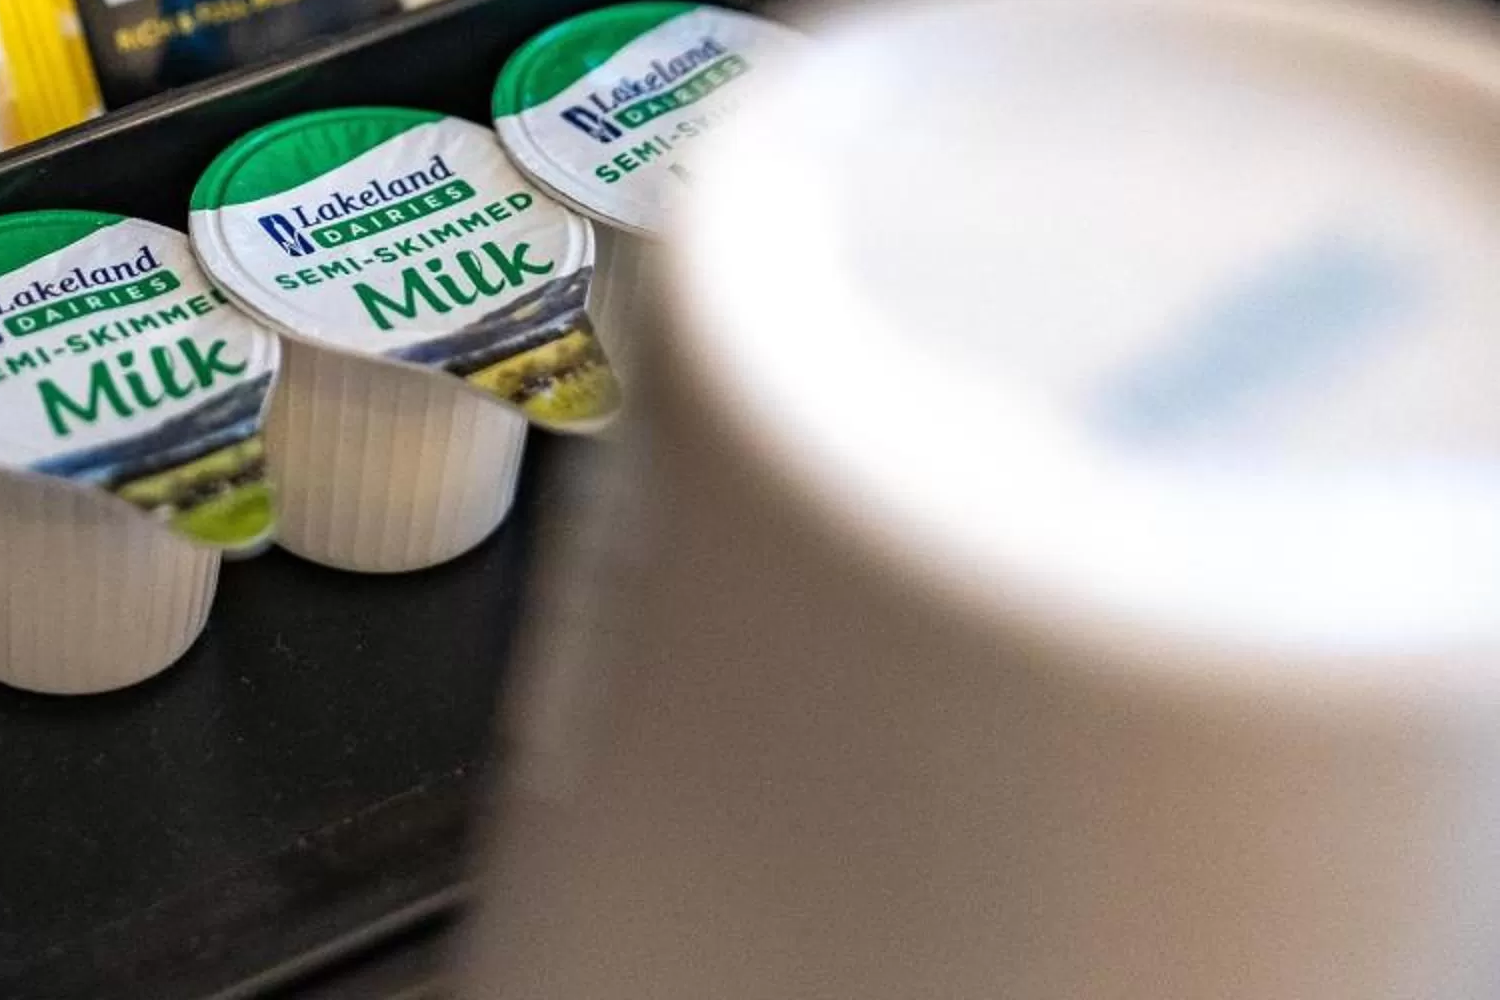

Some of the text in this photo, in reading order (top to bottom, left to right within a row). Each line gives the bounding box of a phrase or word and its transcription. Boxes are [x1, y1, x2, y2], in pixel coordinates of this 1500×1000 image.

[587, 35, 729, 114] Lakeland
[624, 55, 743, 124] DAIRIES
[292, 153, 457, 229] Lakeland
[324, 185, 464, 244] DAIRIES
[274, 192, 534, 290] SEMI-SKIMMED
[14, 276, 171, 333] DAIRIES
[352, 241, 555, 331] Milk
[37, 336, 249, 436] Milk
